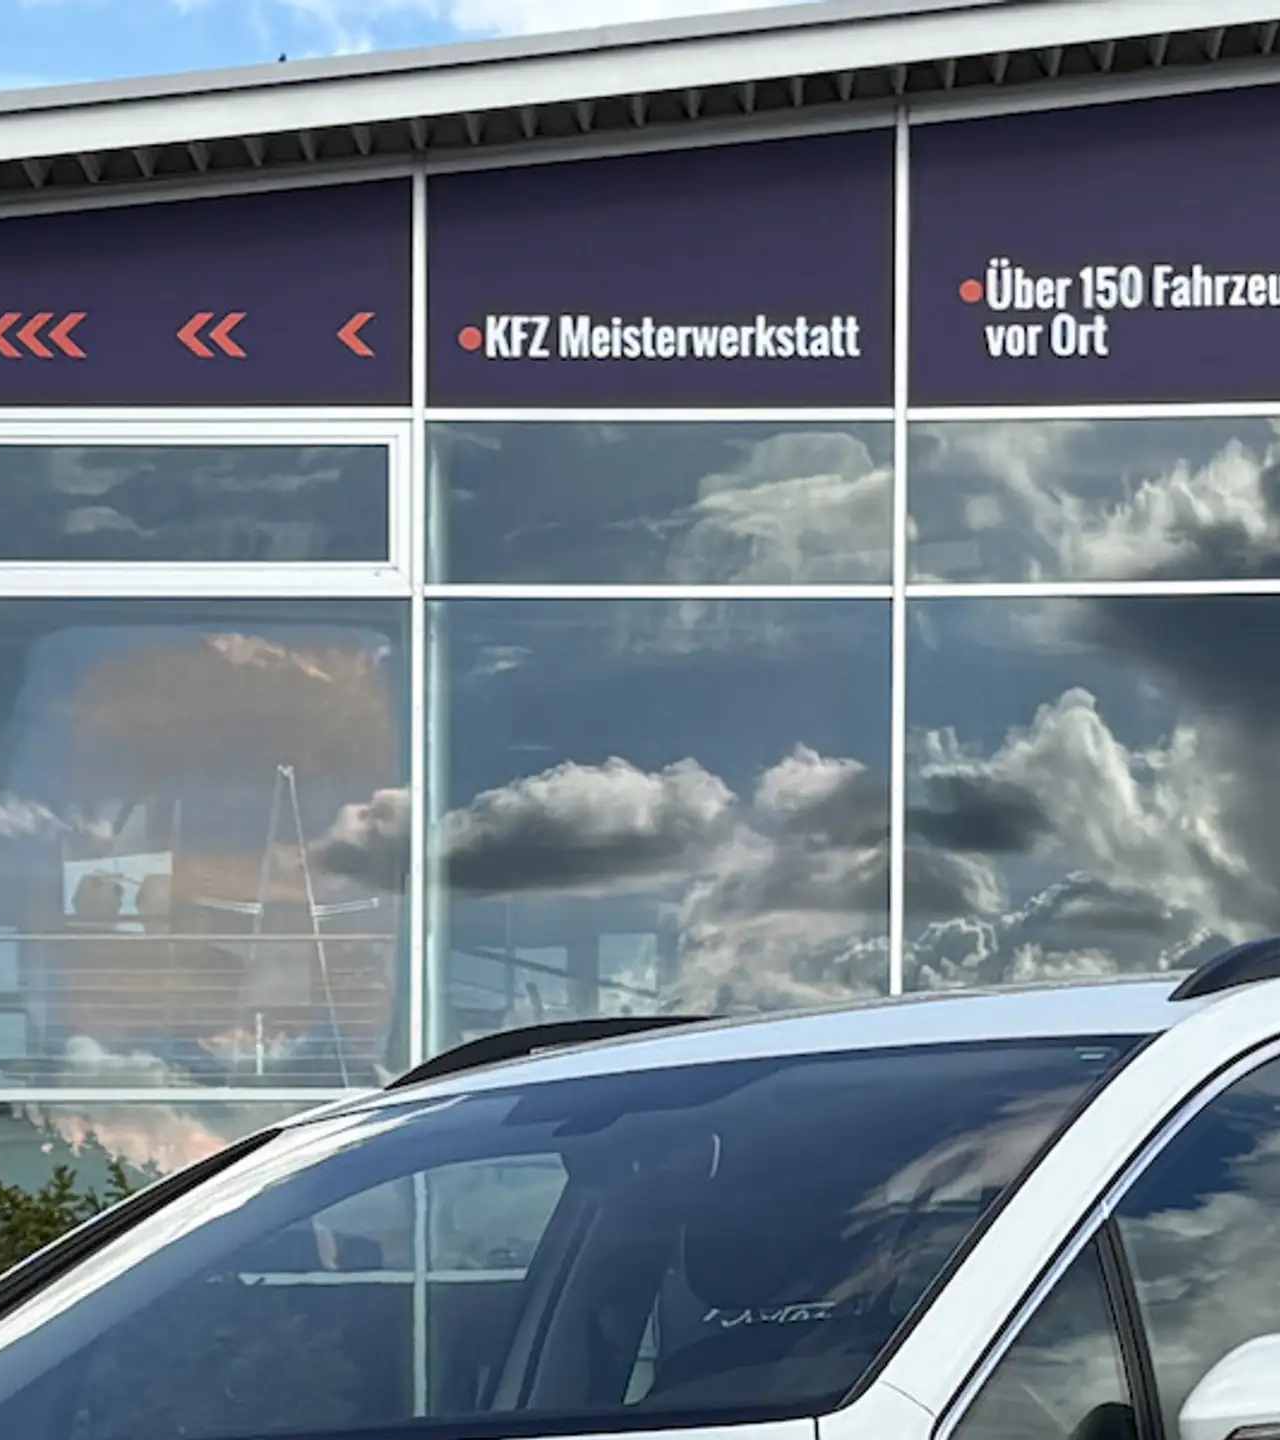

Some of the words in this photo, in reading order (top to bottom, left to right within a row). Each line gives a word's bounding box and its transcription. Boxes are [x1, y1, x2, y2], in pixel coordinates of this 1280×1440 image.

[986, 258, 1073, 311] Über
[1079, 265, 1144, 310] 150
[486, 315, 550, 358] KFZ
[559, 314, 861, 359] Meisterwerkstatt
[985, 323, 1043, 358] vor
[1051, 312, 1109, 357] Ort
